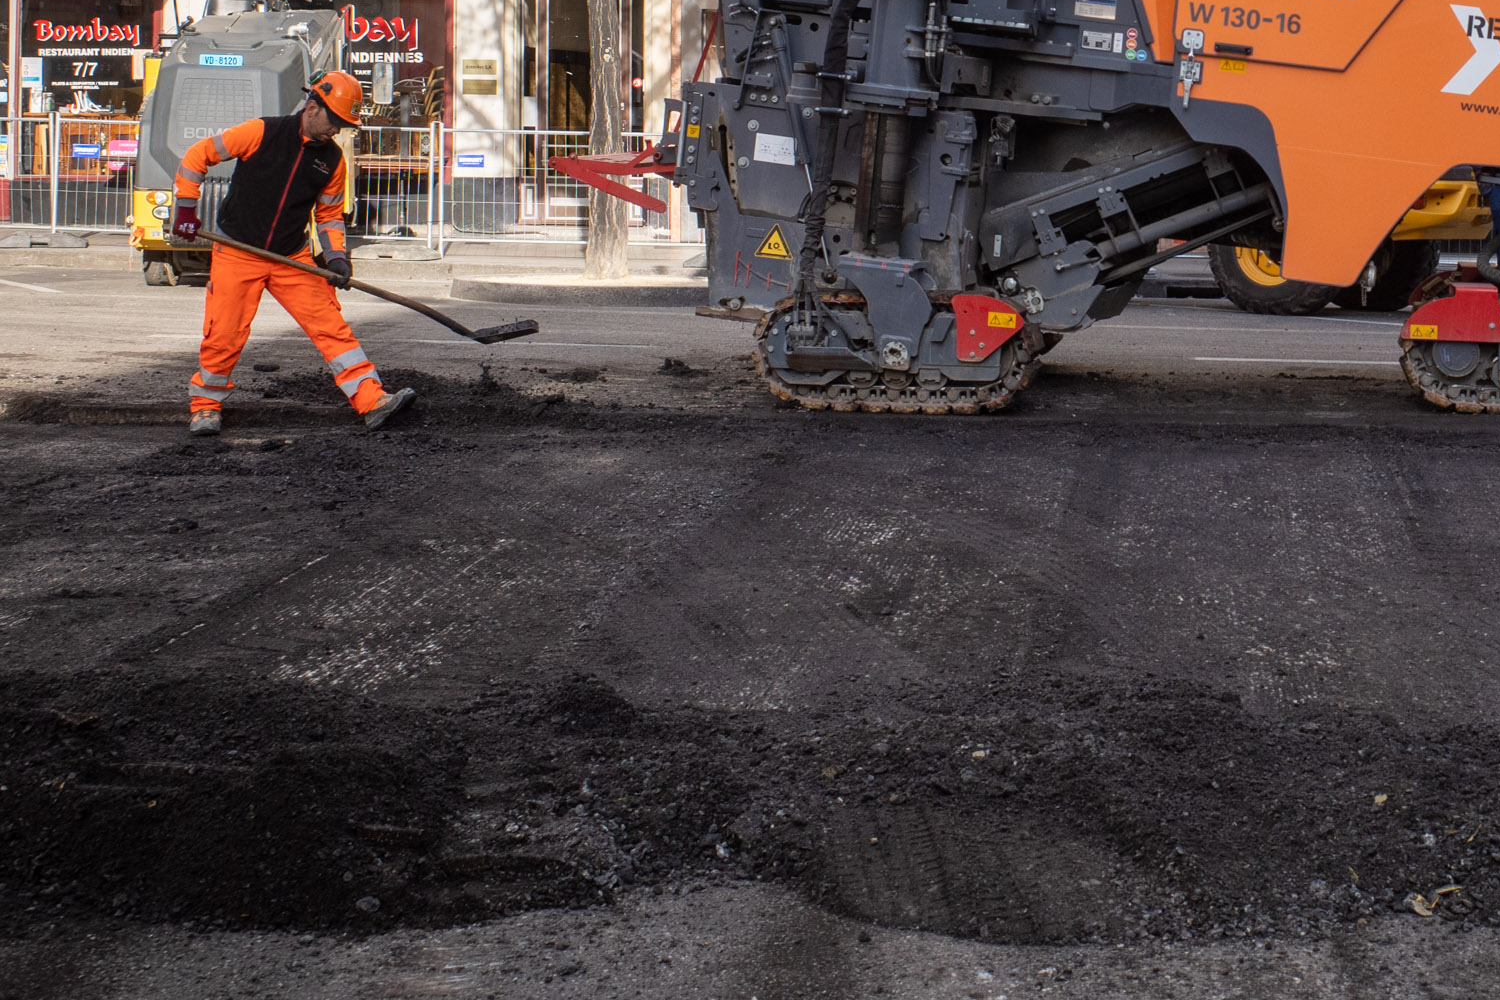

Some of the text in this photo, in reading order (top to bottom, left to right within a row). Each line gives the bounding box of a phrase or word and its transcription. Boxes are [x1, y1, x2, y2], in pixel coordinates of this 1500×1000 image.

[1189, 1, 1302, 35] W 130-16
[33, 17, 140, 47] Bombay
[38, 48, 134, 56] RESTAURANT INDIEN
[351, 52, 424, 63] NDIENNES
[72, 61, 98, 78] 7/7
